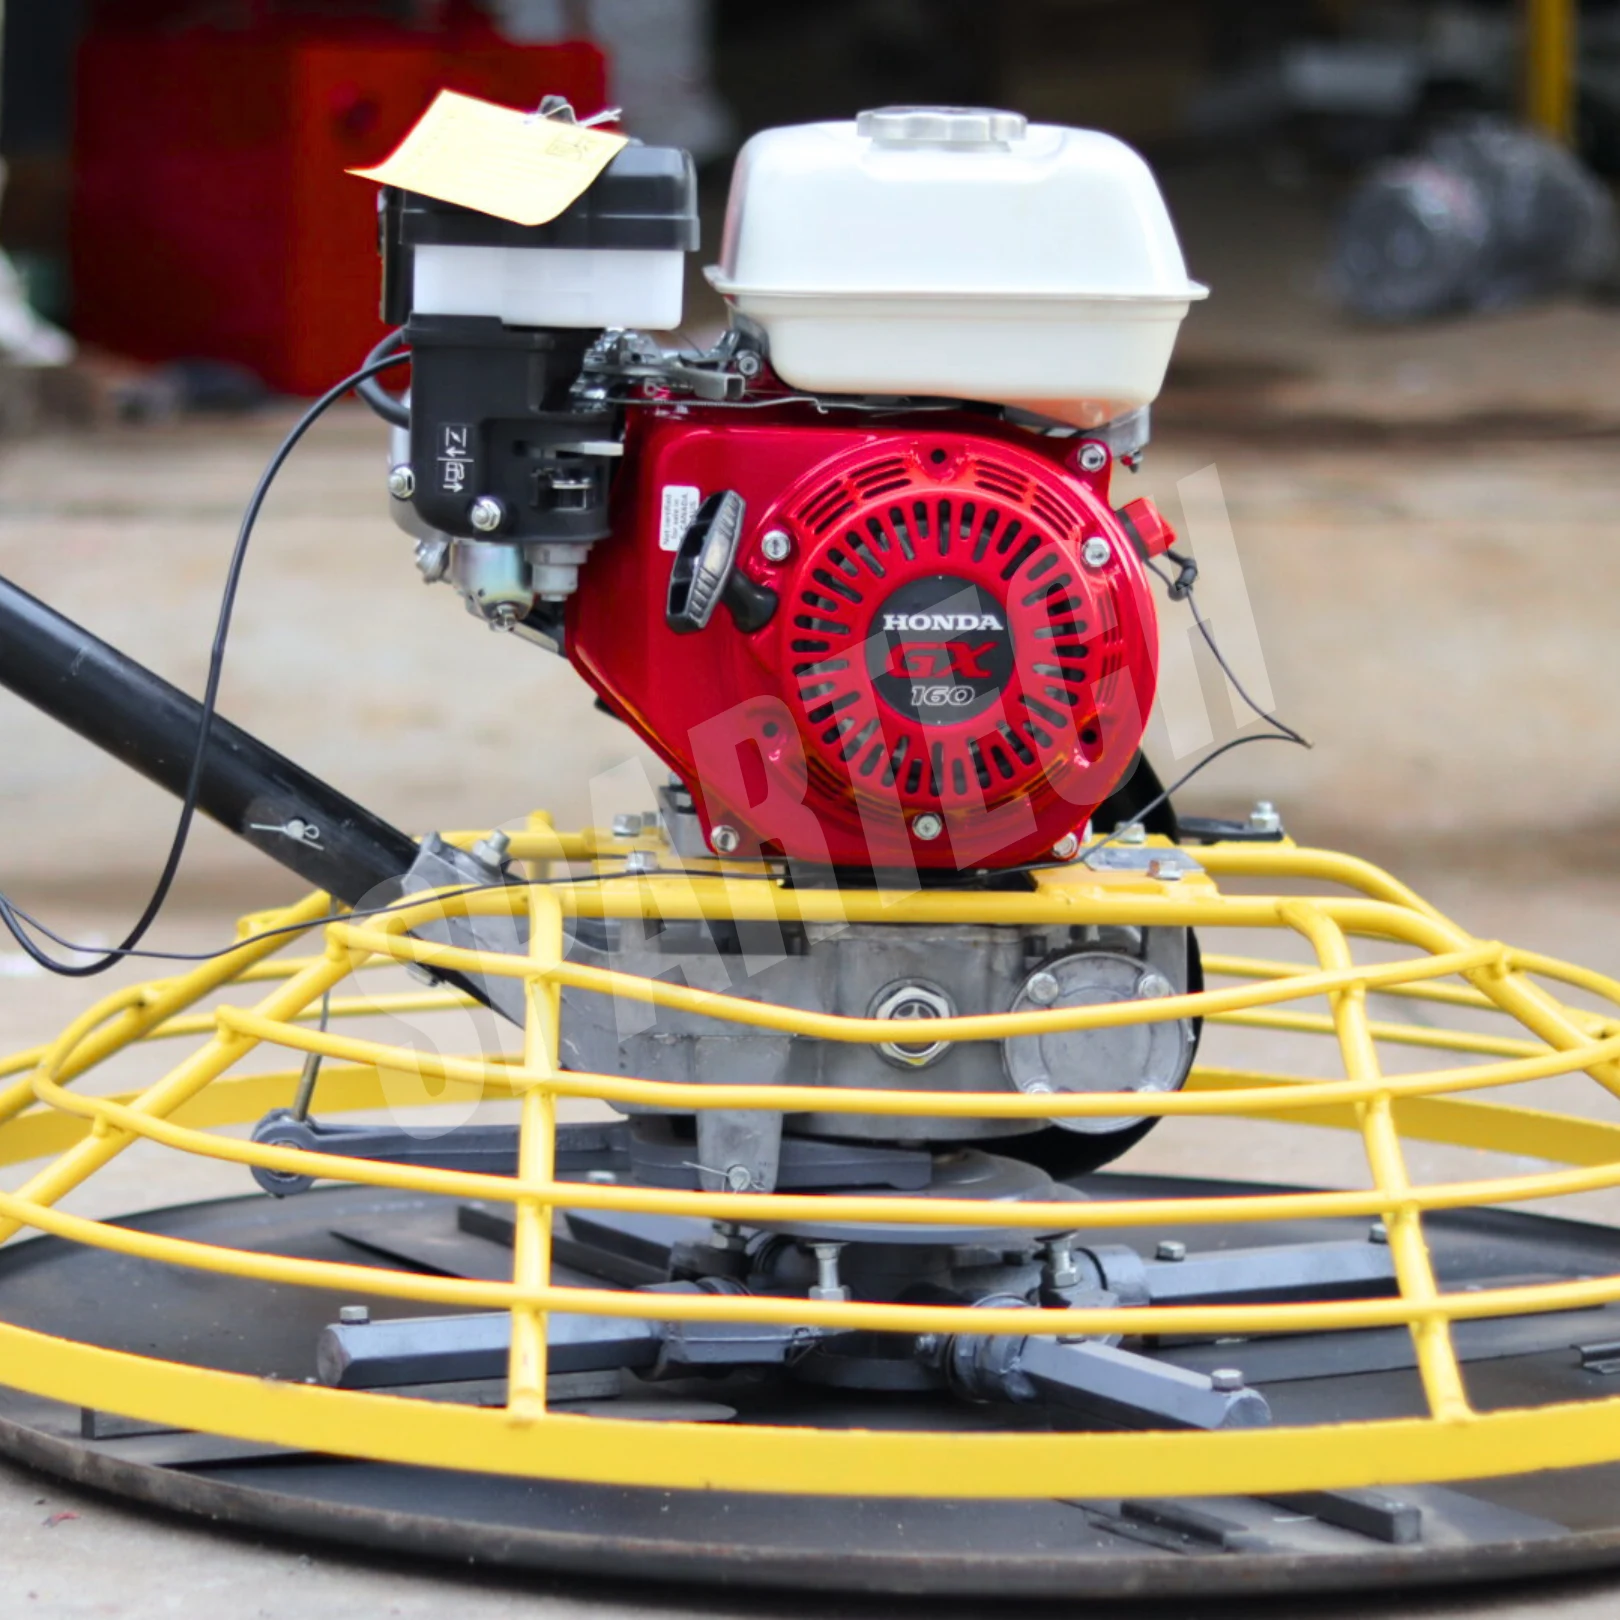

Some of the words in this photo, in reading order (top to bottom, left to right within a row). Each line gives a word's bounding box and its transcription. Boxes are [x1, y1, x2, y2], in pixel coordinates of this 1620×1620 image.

[883, 614, 1004, 631] HONDA
[884, 641, 998, 679] GX
[911, 685, 976, 706] 160
